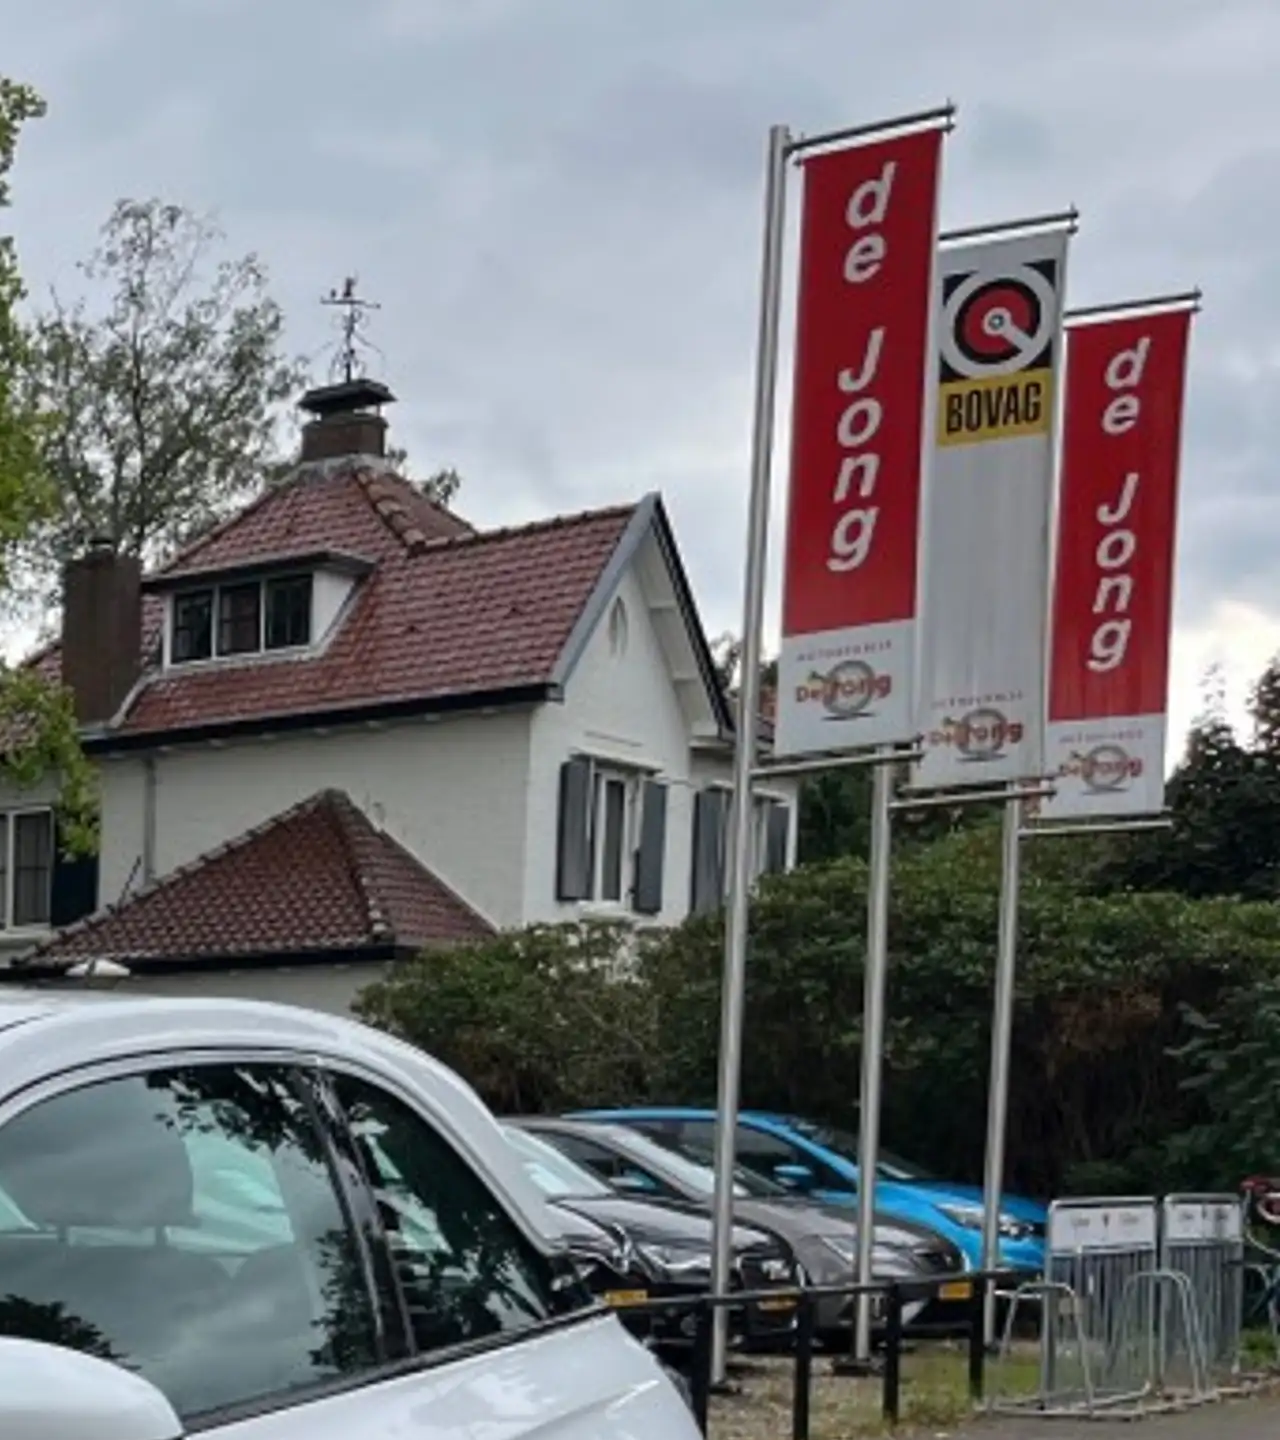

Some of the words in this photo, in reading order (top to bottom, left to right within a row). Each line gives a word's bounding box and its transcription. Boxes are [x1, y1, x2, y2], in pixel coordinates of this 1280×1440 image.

[844, 160, 897, 283] de
[946, 382, 1042, 436] BOVAG
[1101, 336, 1152, 435] de
[826, 326, 887, 572] Jong
[1086, 472, 1140, 672] Jong
